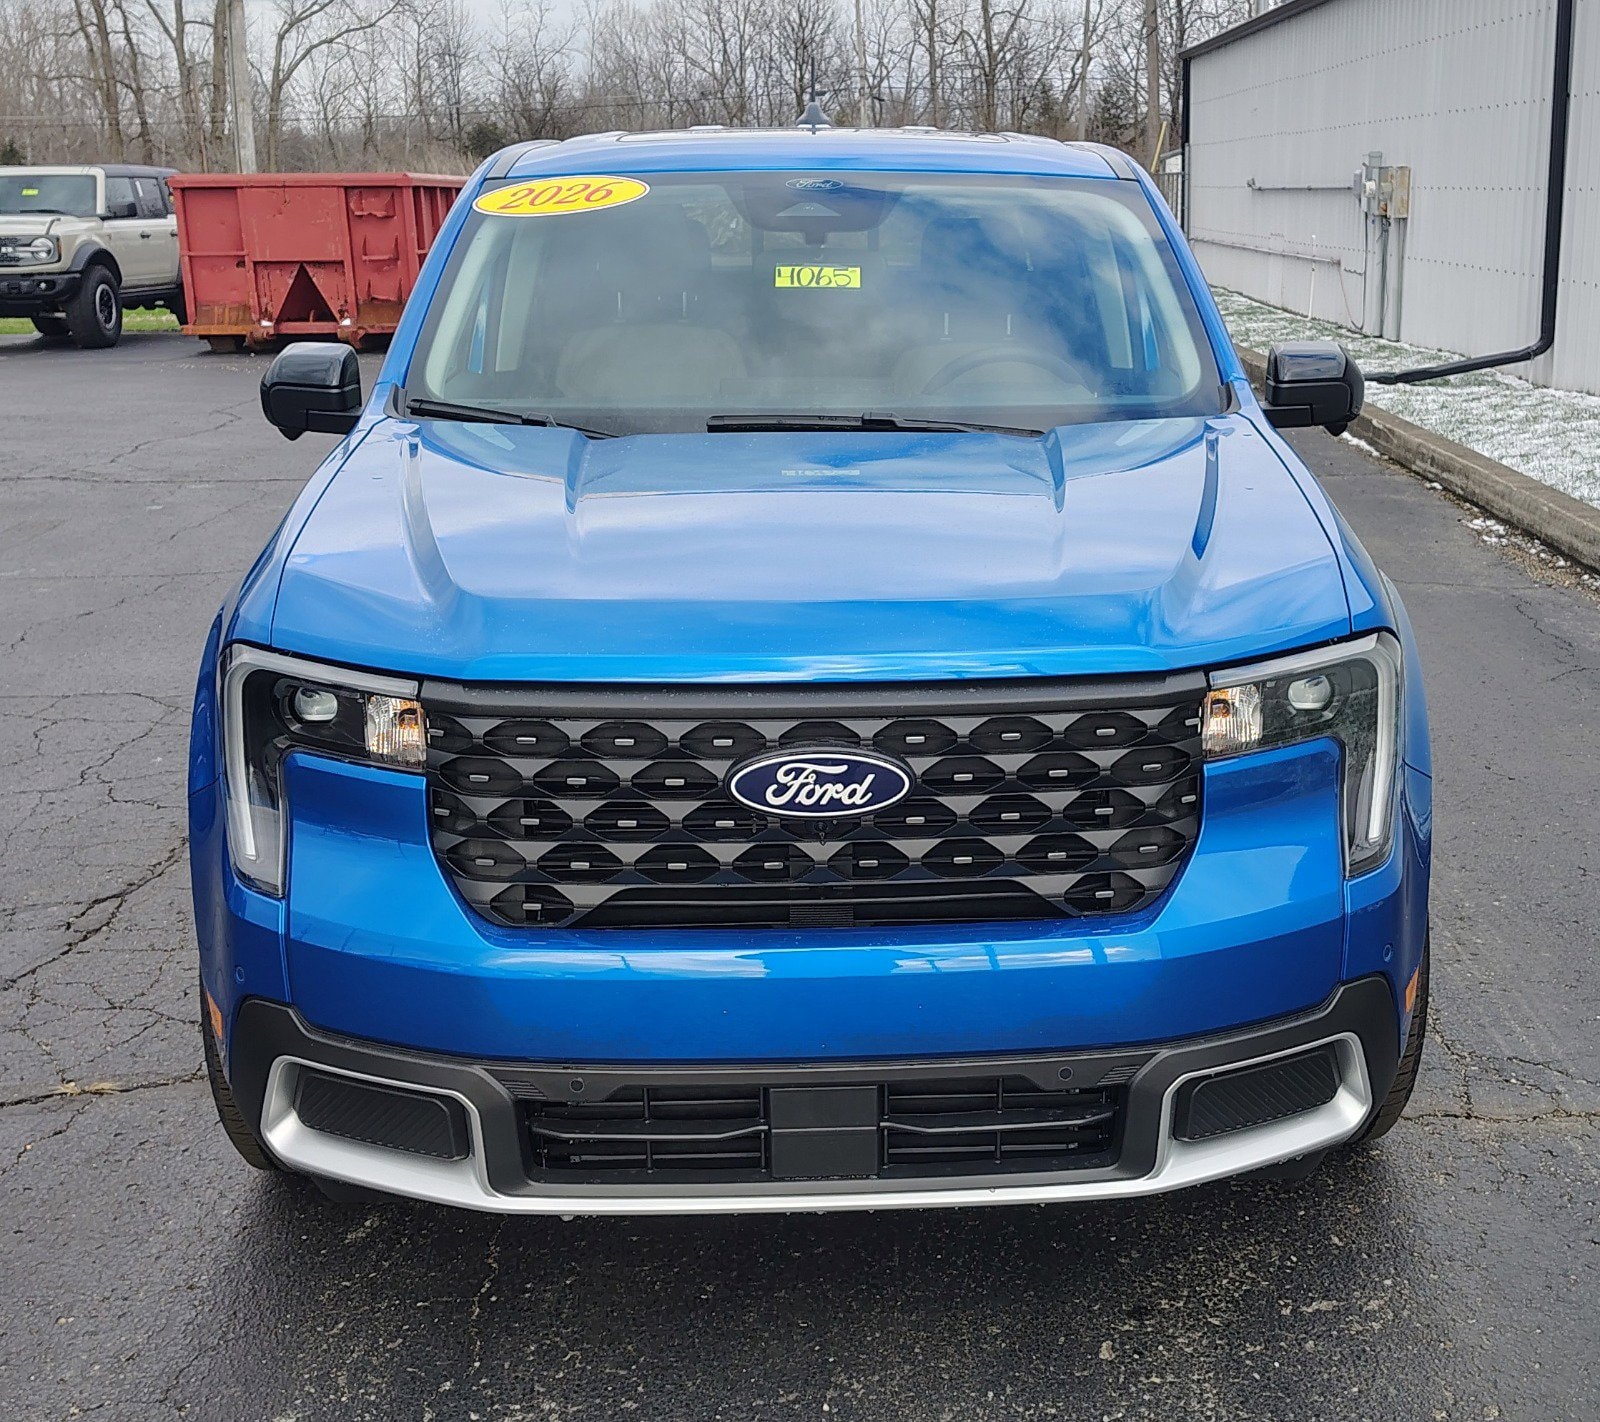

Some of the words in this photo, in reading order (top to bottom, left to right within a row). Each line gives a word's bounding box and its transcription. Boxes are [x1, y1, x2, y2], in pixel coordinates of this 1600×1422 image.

[497, 181, 623, 210] 2026
[796, 179, 833, 188] Ford
[777, 267, 855, 287] 4065
[765, 762, 876, 806] Ford
